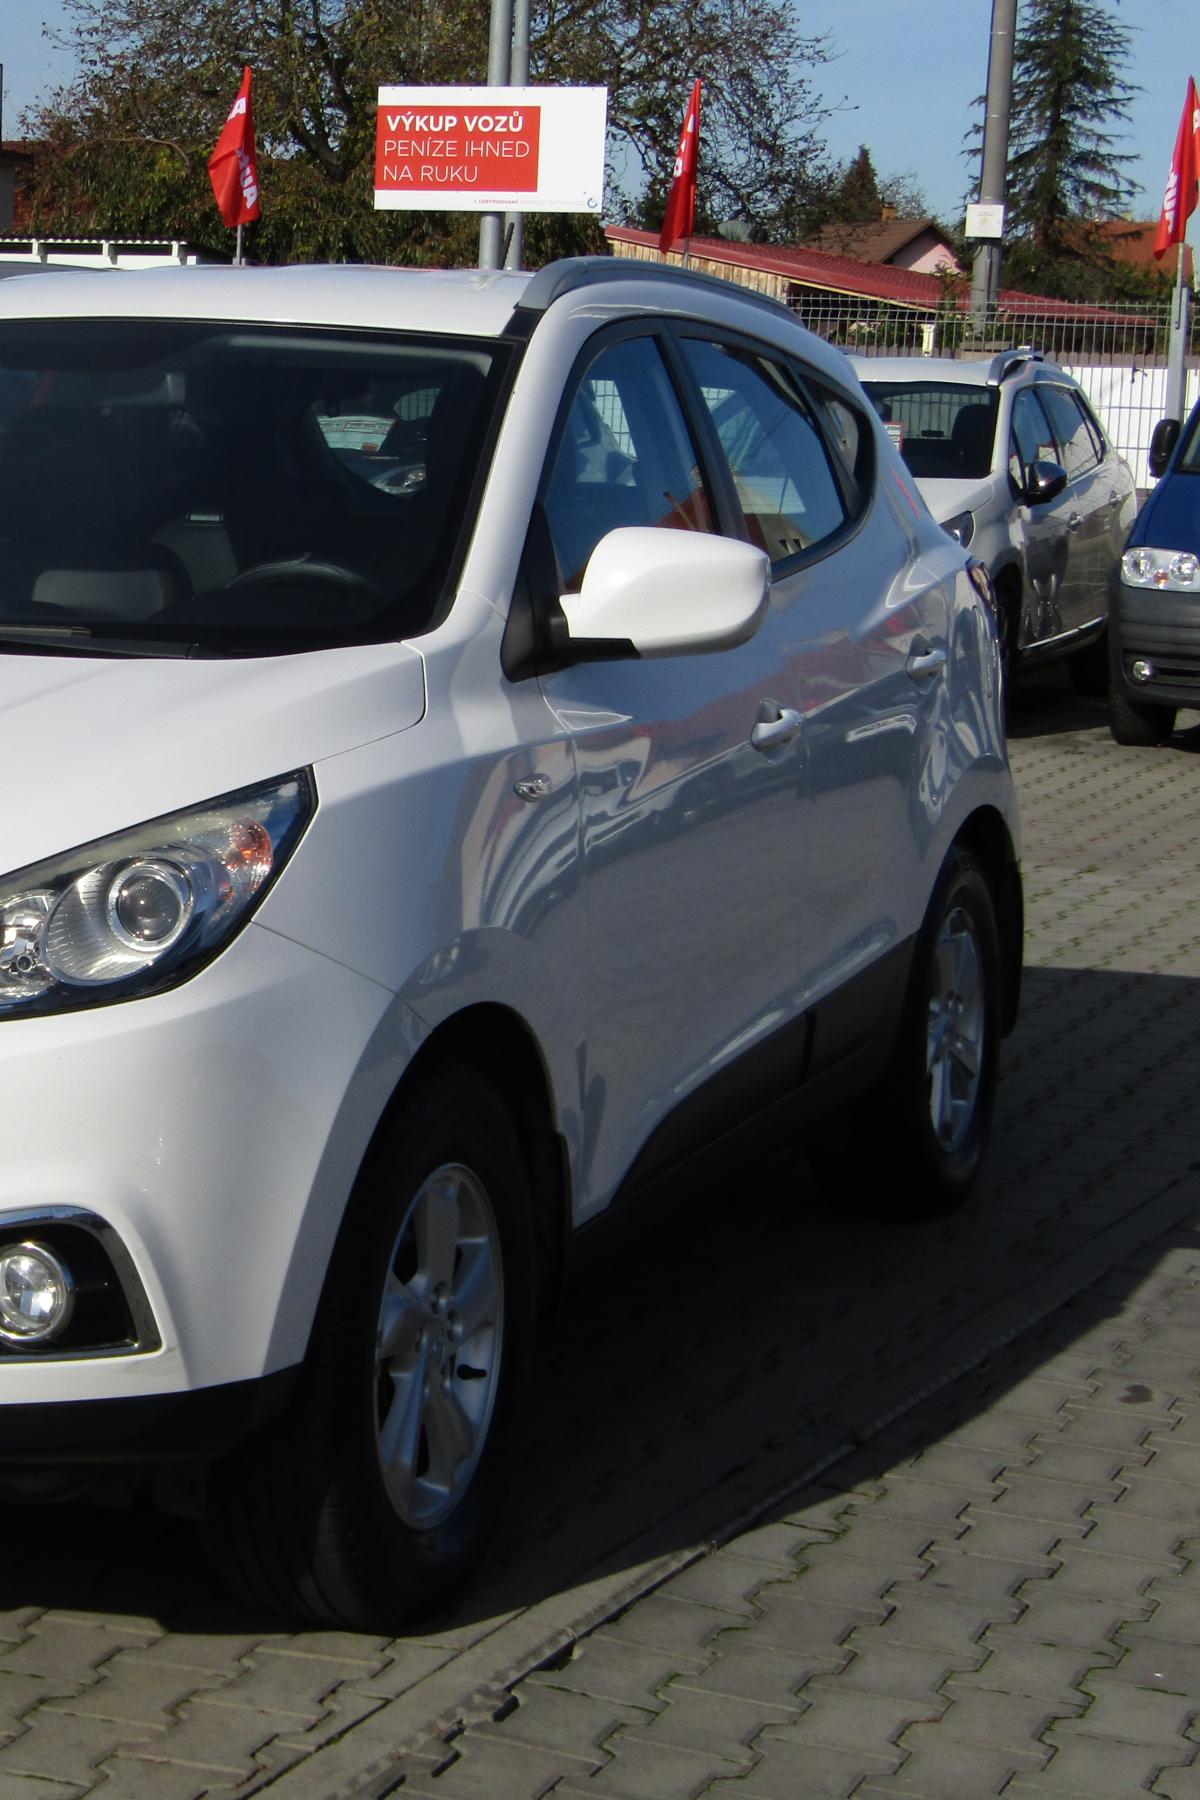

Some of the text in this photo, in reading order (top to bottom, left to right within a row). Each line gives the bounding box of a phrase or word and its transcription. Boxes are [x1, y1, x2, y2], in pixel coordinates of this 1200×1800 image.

[386, 111, 523, 132] VÝKUP VOZŮ
[384, 137, 530, 158] PENÍZE IHNED
[383, 165, 478, 182] NA RUKU
